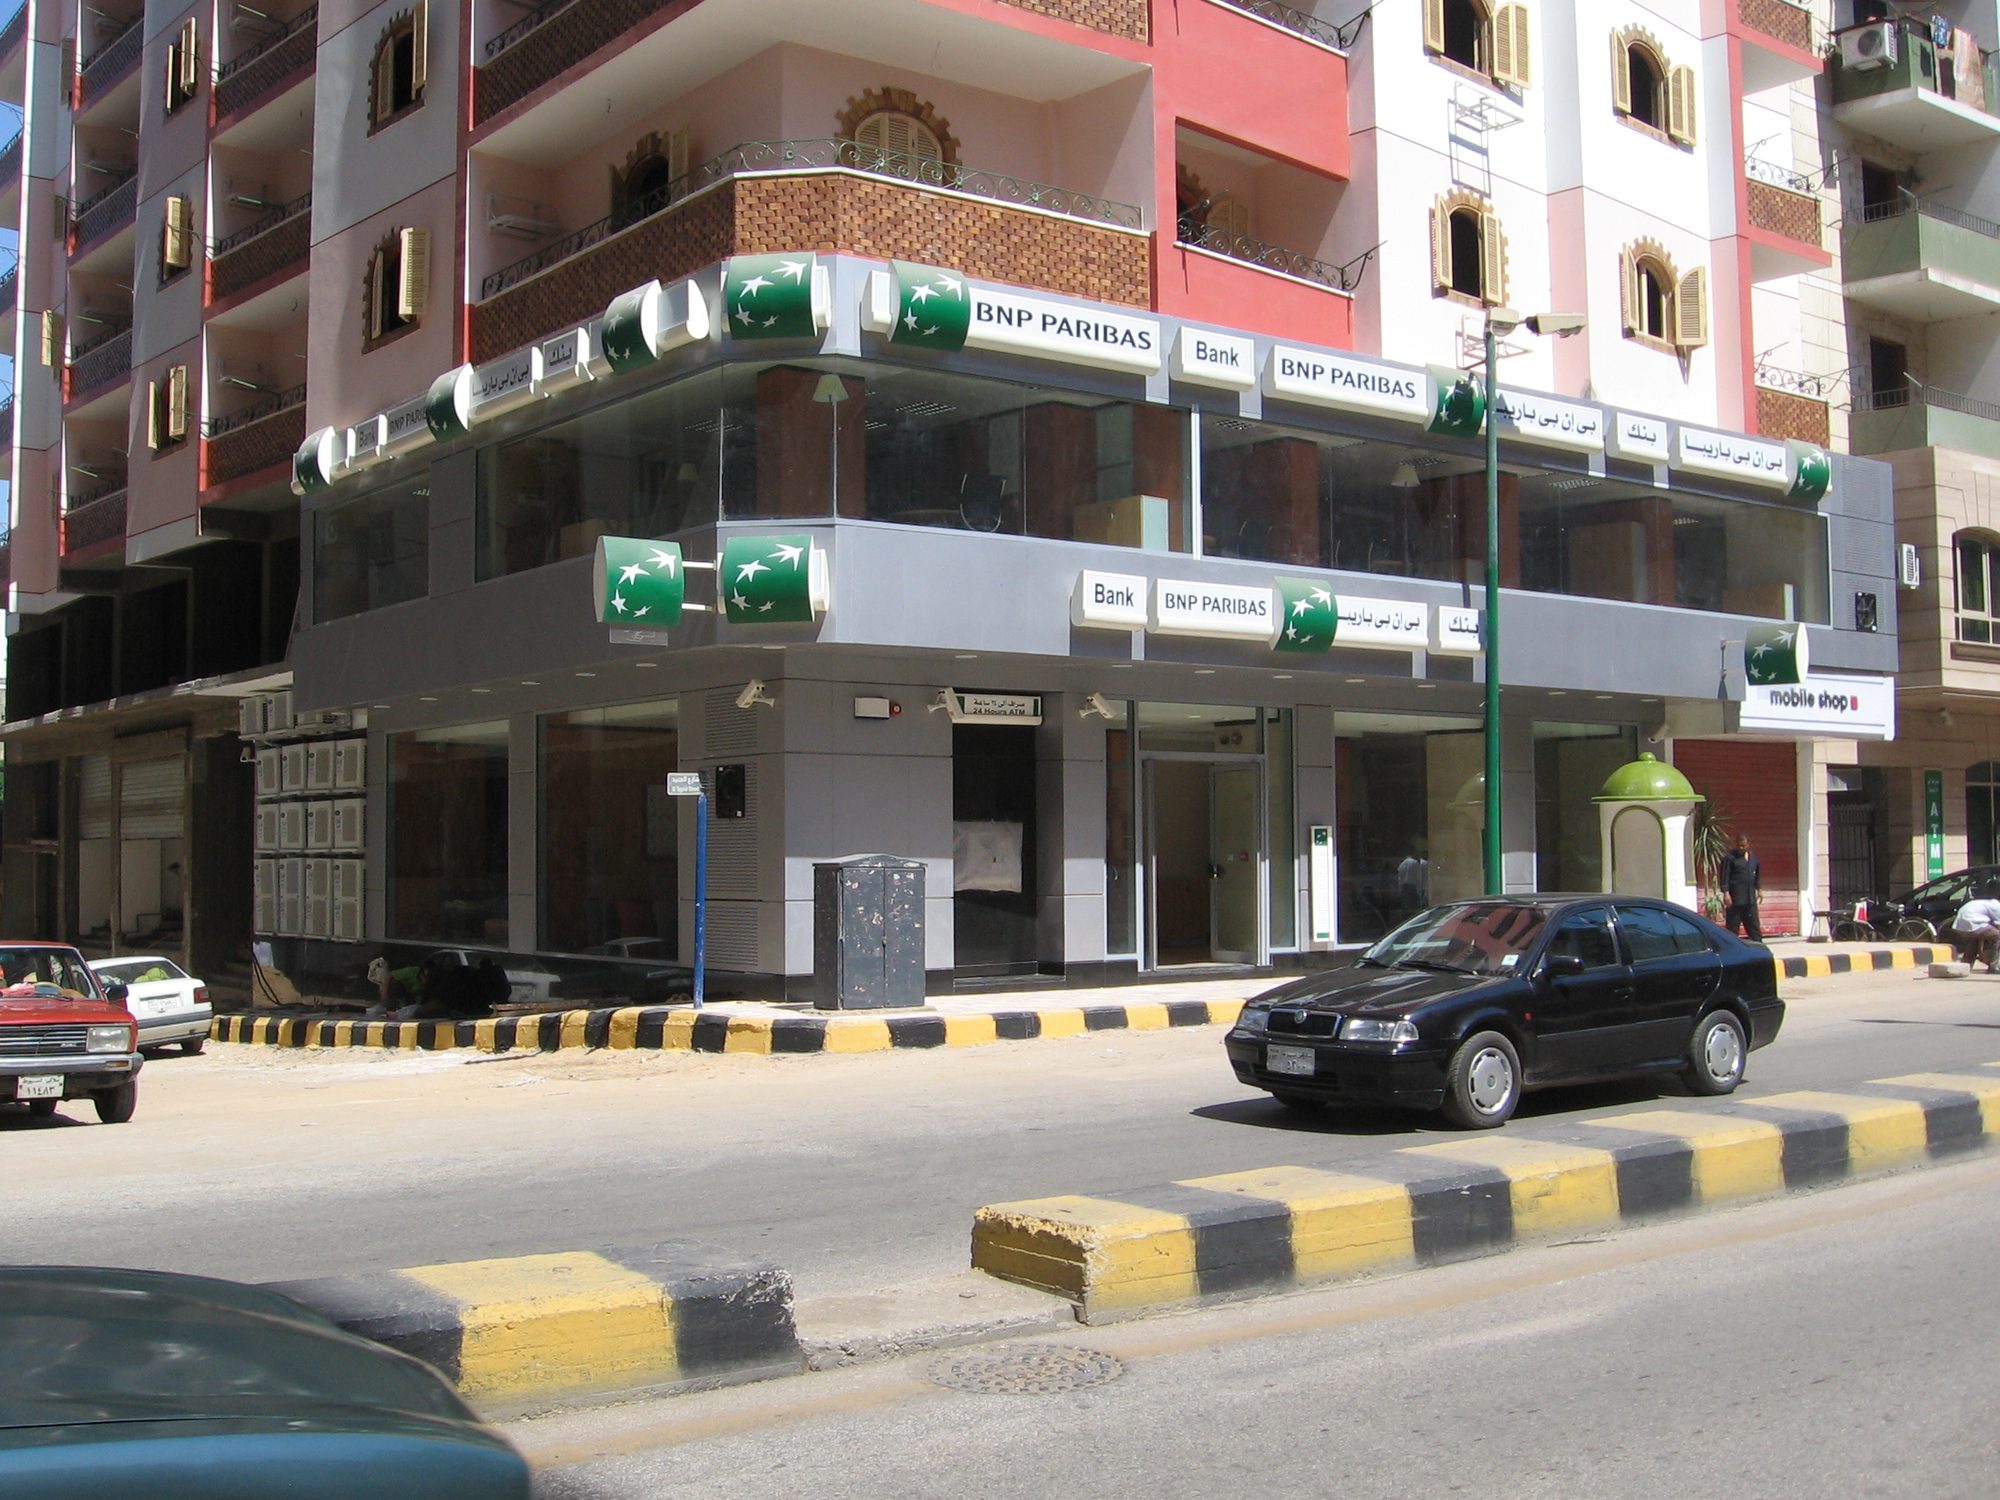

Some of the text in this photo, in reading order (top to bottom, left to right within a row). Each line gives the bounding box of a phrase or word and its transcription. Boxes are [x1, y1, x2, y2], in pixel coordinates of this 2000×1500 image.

[976, 301, 1152, 350] BNP PARIBAS
[1196, 340, 1240, 367] Bank
[1281, 358, 1416, 399] BNP PARIBAS
[389, 416, 404, 434] BNP
[1496, 402, 1536, 424] باريب
[359, 426, 376, 447] Bank
[1627, 423, 1657, 446] بنك
[1094, 583, 1134, 607] Bank
[1165, 592, 1267, 616] BNP PARIBAS
[1338, 607, 1373, 627] باريب
[1449, 615, 1480, 638] بنك
[1769, 687, 1848, 714] mobile shop
[1930, 802, 1941, 858] ATM
